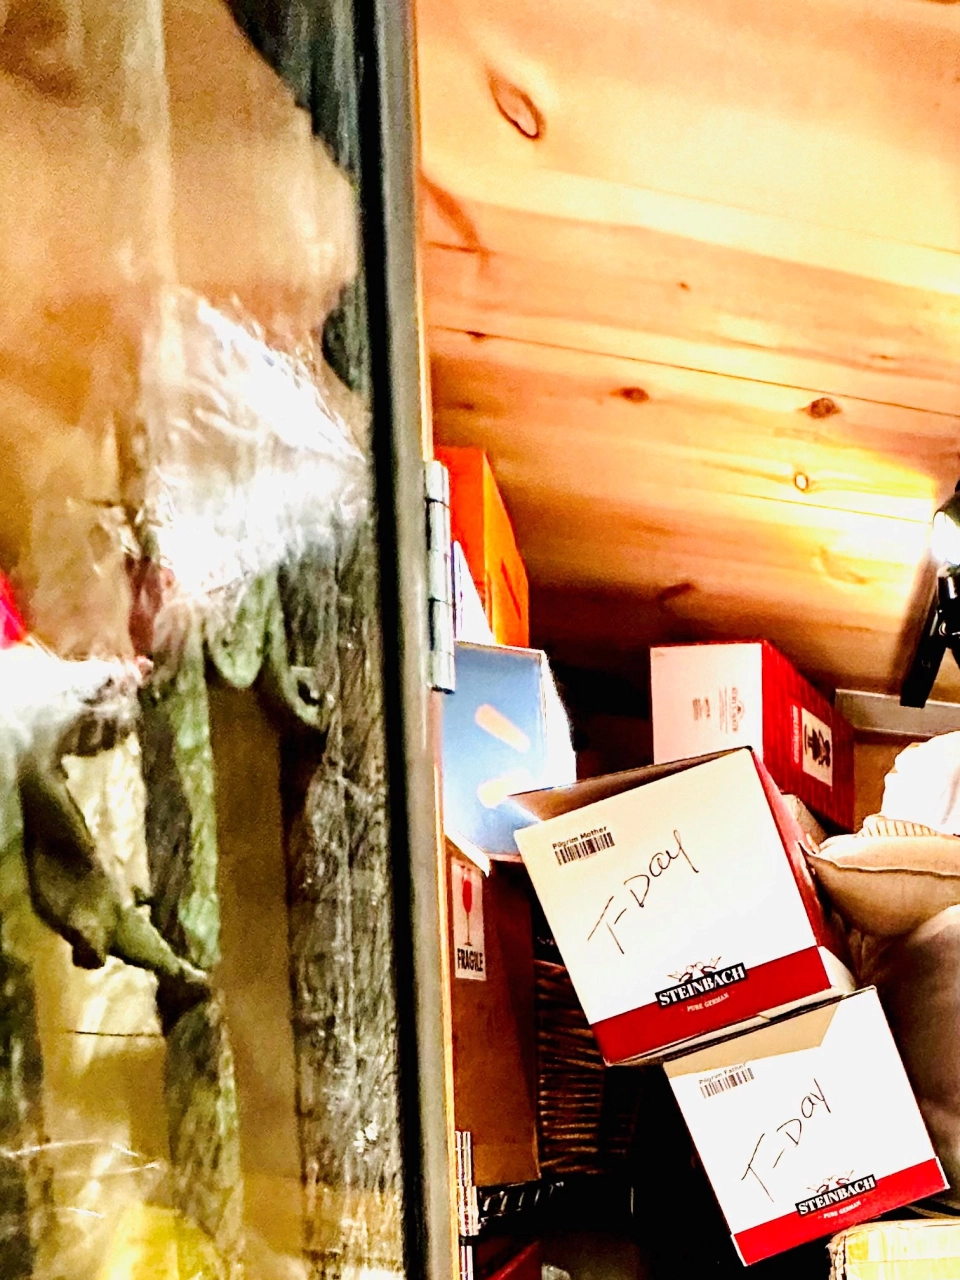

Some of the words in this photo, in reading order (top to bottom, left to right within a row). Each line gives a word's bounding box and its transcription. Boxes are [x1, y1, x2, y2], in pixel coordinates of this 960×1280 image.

[580, 826, 607, 840] Mother
[658, 965, 745, 1007] STEINBACH
[798, 1176, 876, 1216] STEINBACH
